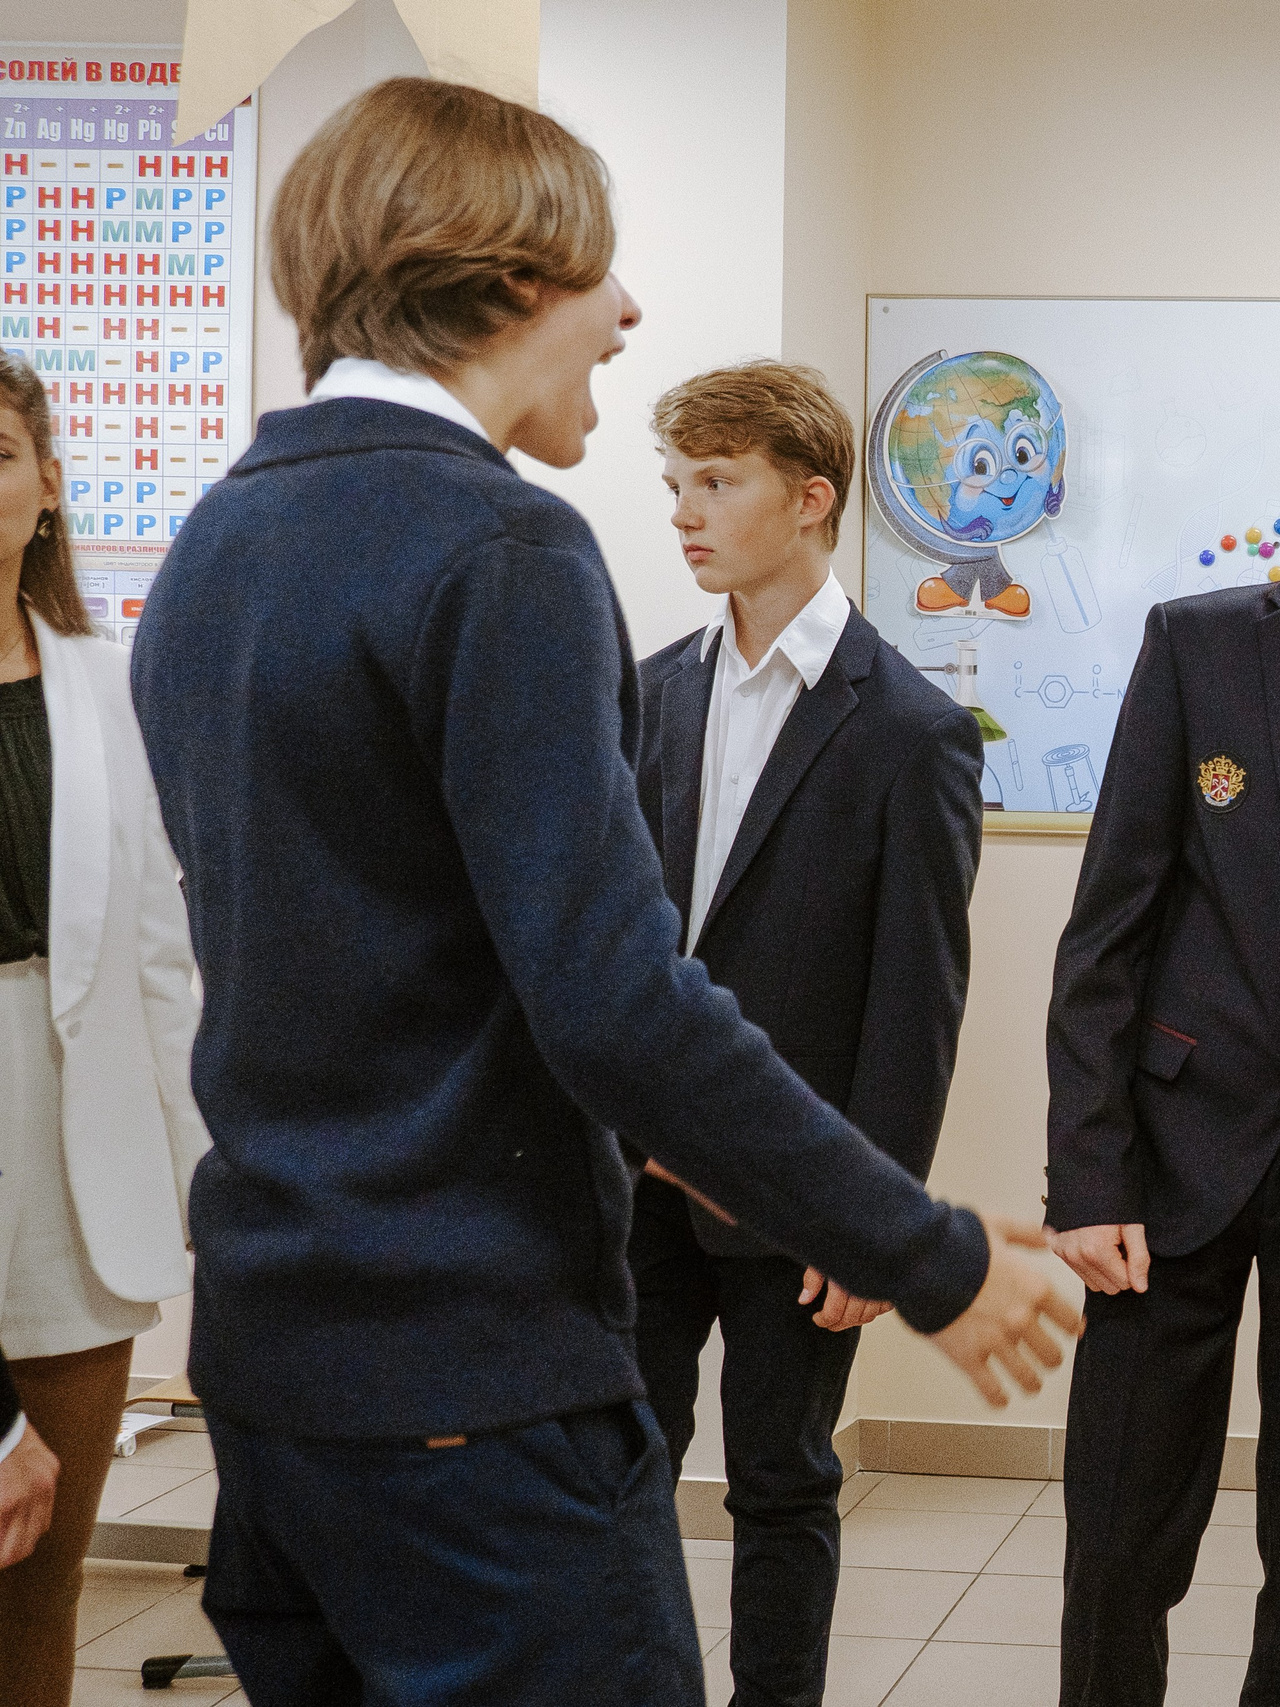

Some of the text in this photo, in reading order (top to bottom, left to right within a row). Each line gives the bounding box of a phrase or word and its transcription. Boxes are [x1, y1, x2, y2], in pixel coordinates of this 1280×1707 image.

[86, 62, 102, 81] В
[110, 62, 181, 86] ВОДЕ
[4, 117, 27, 139] Zn
[37, 118, 61, 142] Ag
[70, 119, 95, 143] Hg
[104, 119, 129, 143] Hg
[138, 120, 162, 141] Pb
[5, 154, 228, 177] Н Н Н Н
[6, 186, 225, 210] Р Н Н Р М Р Р
[6, 219, 225, 243] Р Н Н М М Р Р
[6, 252, 224, 276] Р Н Н Н Н М Р
[5, 283, 225, 306] Н Н Н Н Н Н Н
[3, 317, 159, 339] М Н Н Н
[36, 349, 222, 373] М М Н Р Р
[70, 383, 92, 403] Н
[103, 383, 125, 404] Н
[136, 384, 158, 404] Н
[169, 384, 191, 405] Н
[201, 385, 223, 405] Н
[70, 416, 92, 437] Н
[136, 417, 158, 438] Н
[201, 418, 223, 439] Н
[136, 449, 158, 470] Н
[71, 481, 156, 503] Р Р Р
[104, 514, 123, 535] Р
[137, 515, 156, 536] Р
